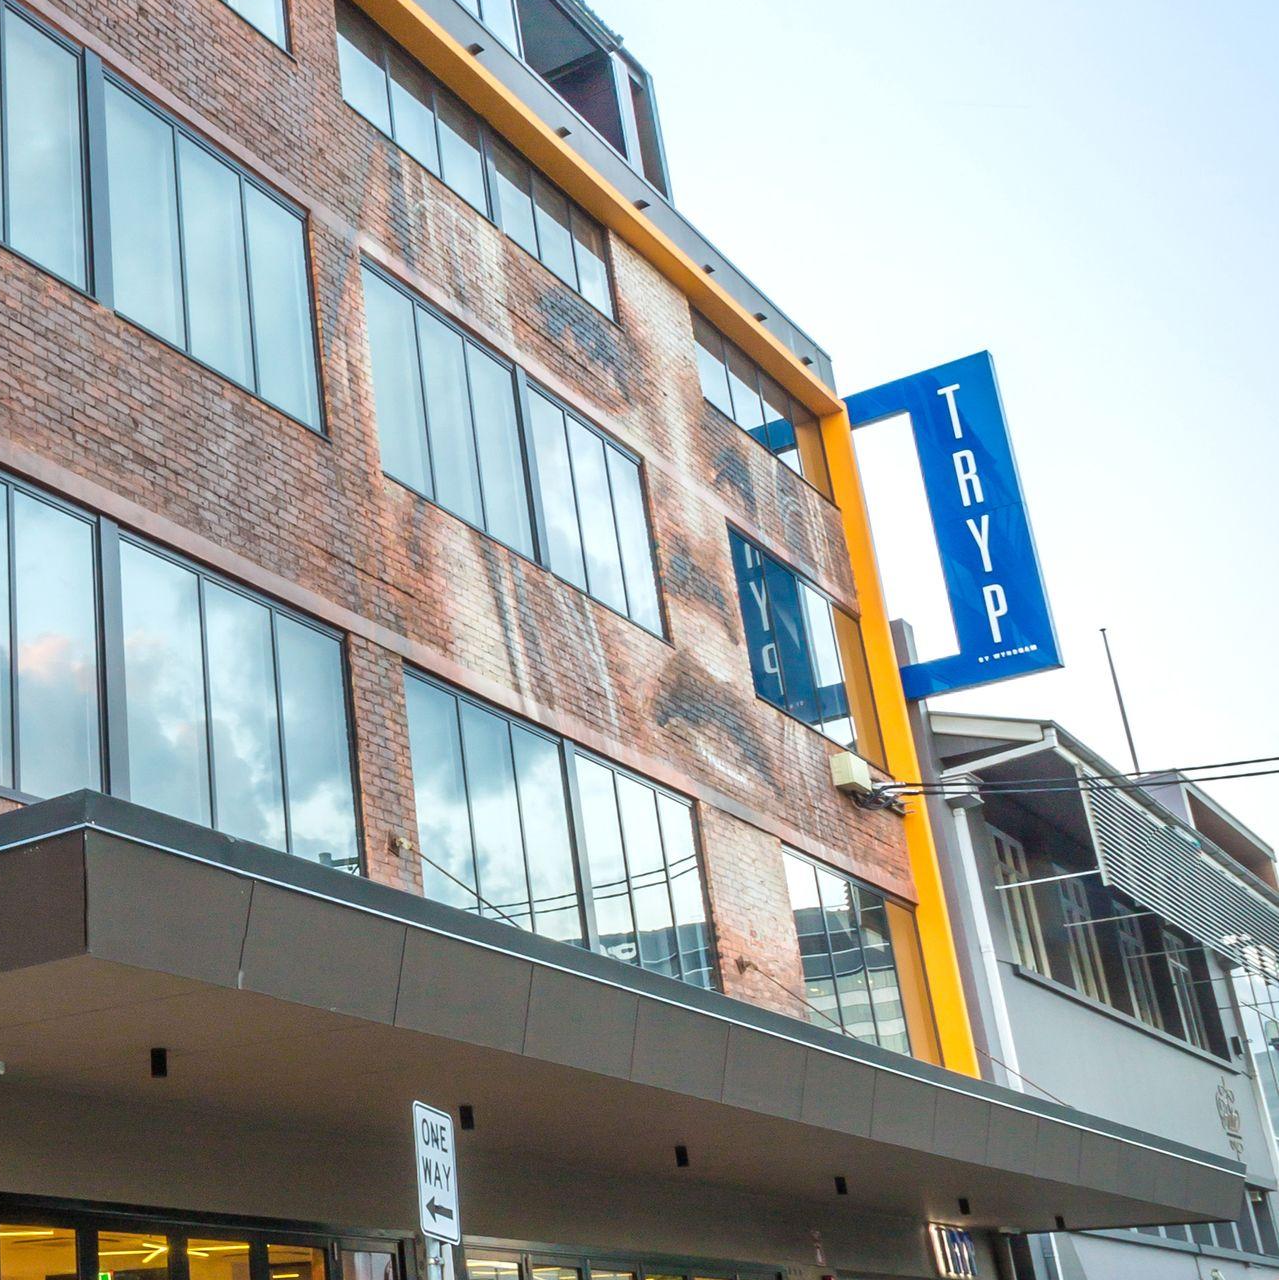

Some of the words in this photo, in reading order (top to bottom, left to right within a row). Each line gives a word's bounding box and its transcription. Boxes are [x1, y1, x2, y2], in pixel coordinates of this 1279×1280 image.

[937, 383, 1008, 644] TRYP
[993, 644, 1038, 659] WYNDHAM
[421, 1118, 448, 1153] ONE
[422, 1157, 451, 1192] WAY
